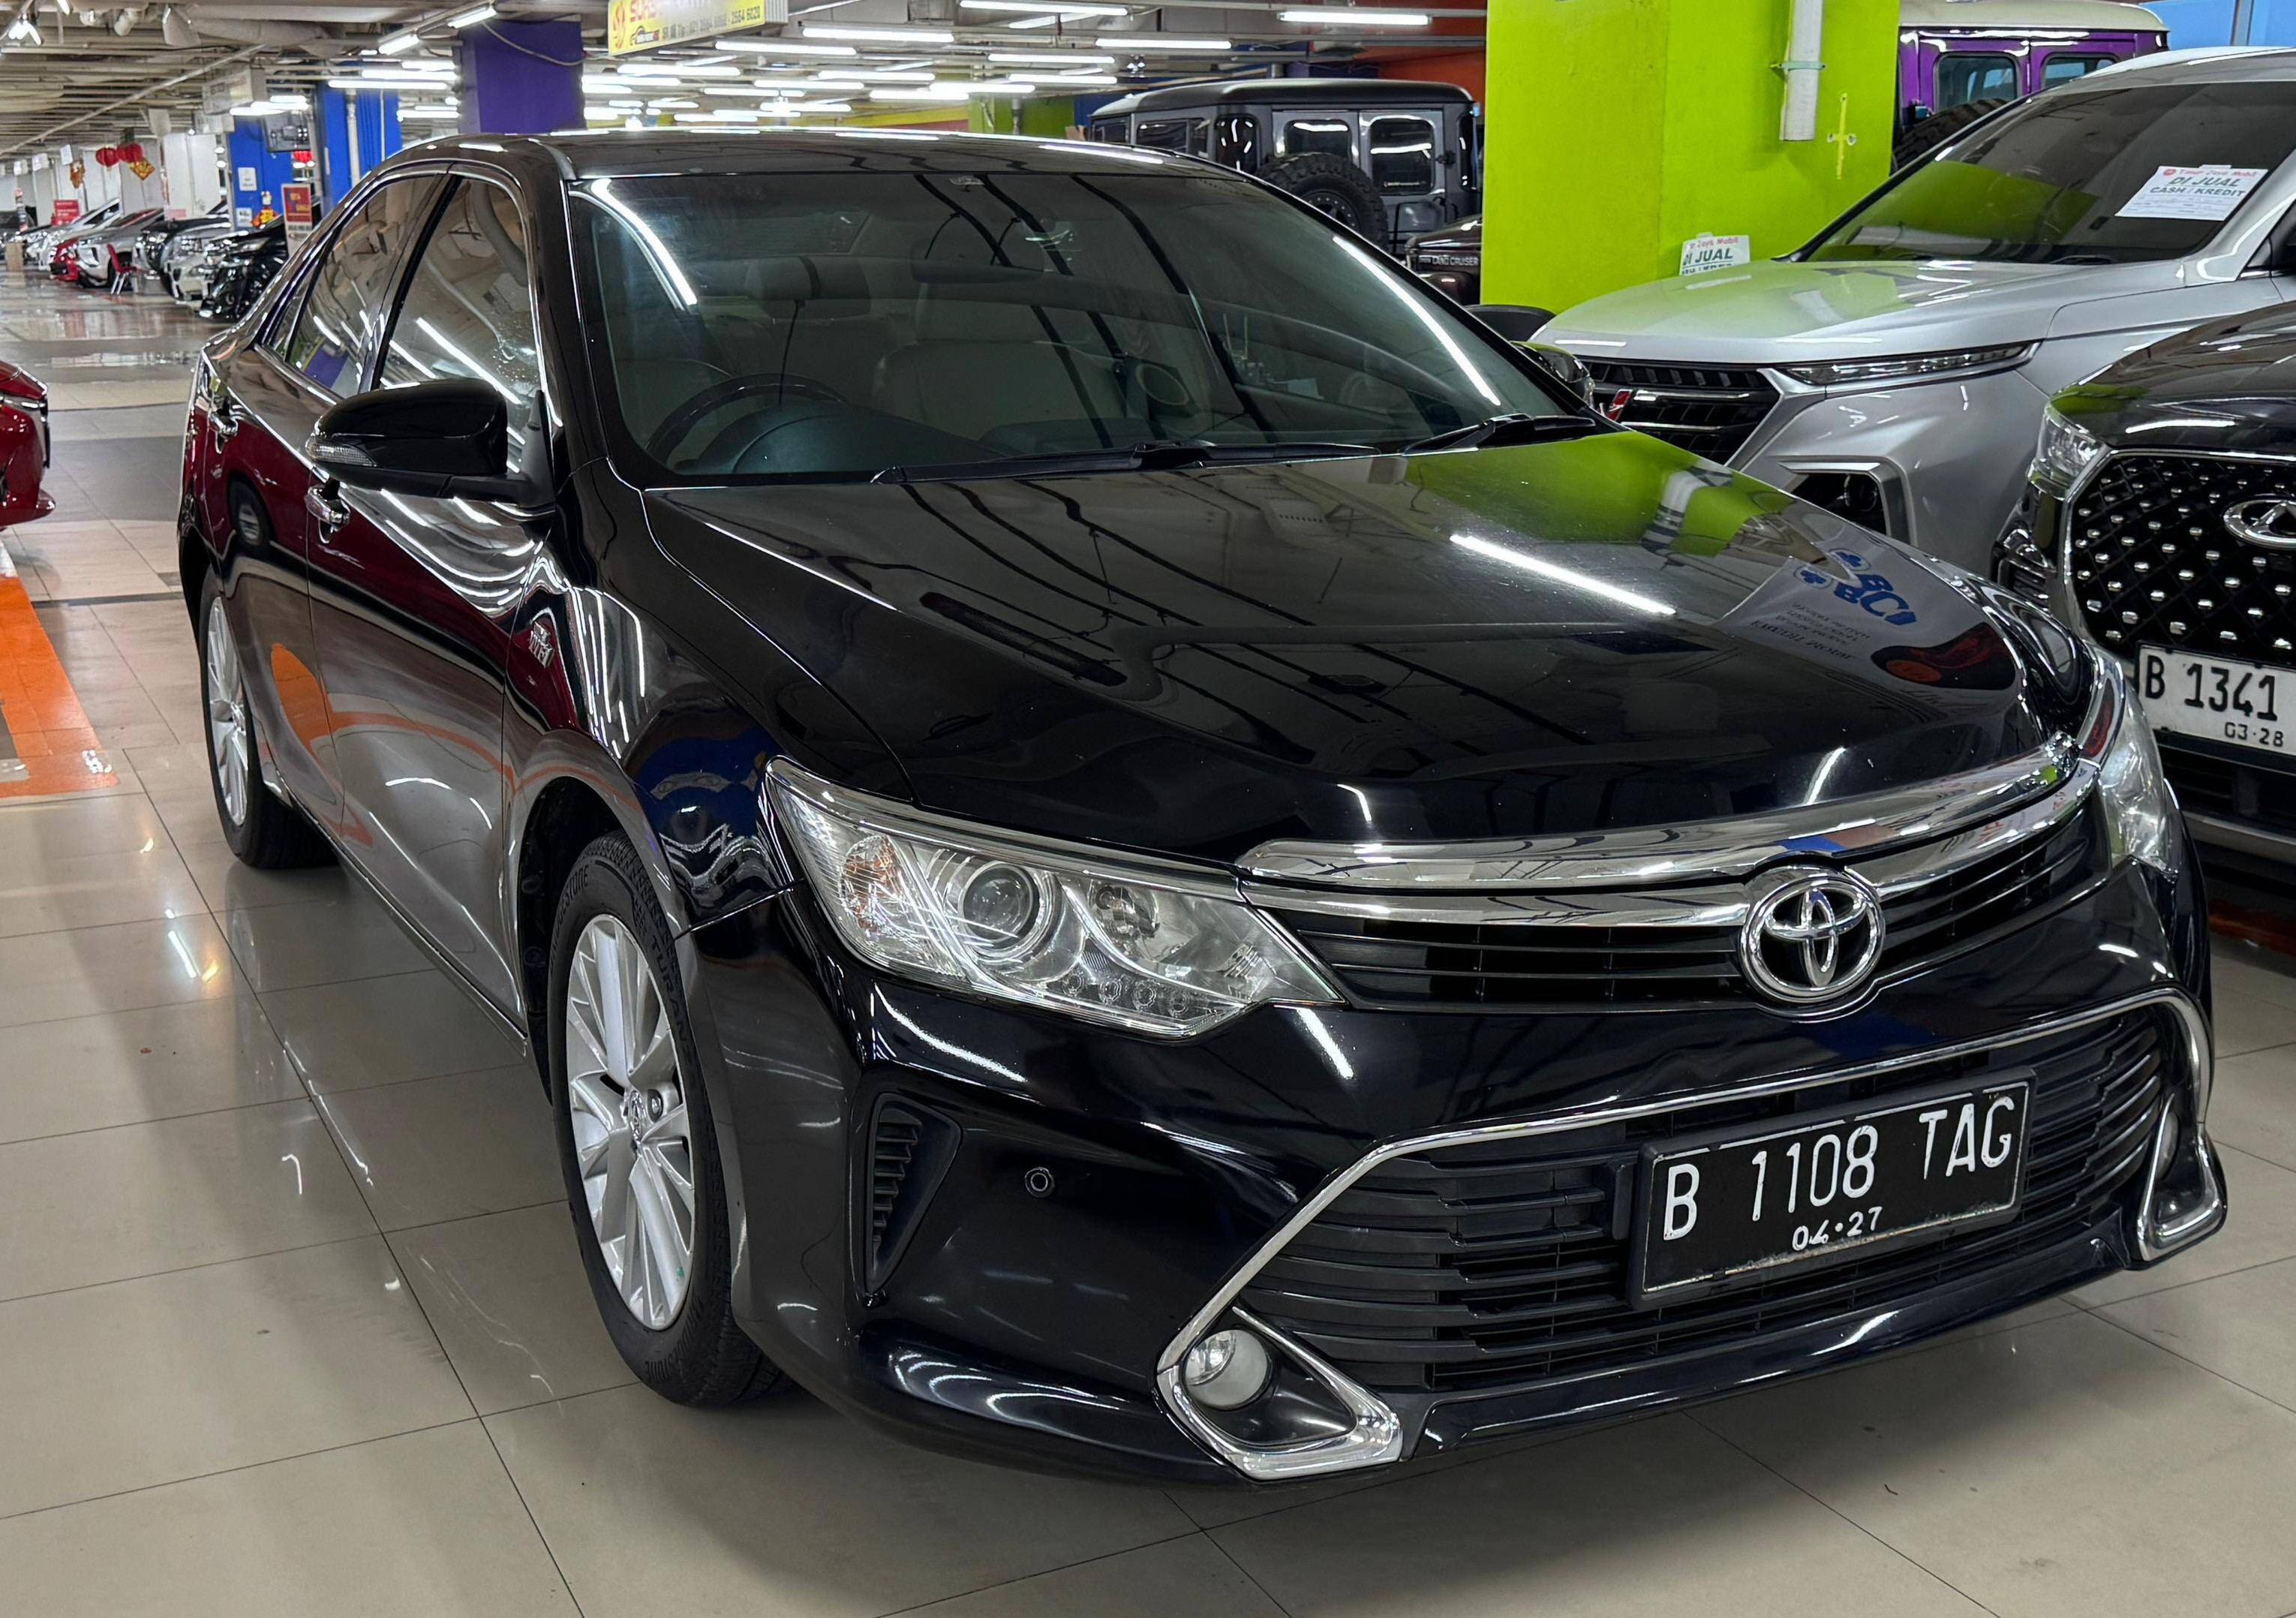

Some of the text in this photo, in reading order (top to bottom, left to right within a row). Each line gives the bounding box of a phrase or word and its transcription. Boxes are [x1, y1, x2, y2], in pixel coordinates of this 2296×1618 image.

[2168, 177, 2242, 187] DI JUAL
[2194, 188, 2246, 197] KREDIT
[1450, 257, 1479, 266] CRUISER
[1695, 248, 1733, 263] JUAL
[2145, 654, 2278, 722] B 1341
[1663, 1097, 2015, 1241] B 1108 TAG
